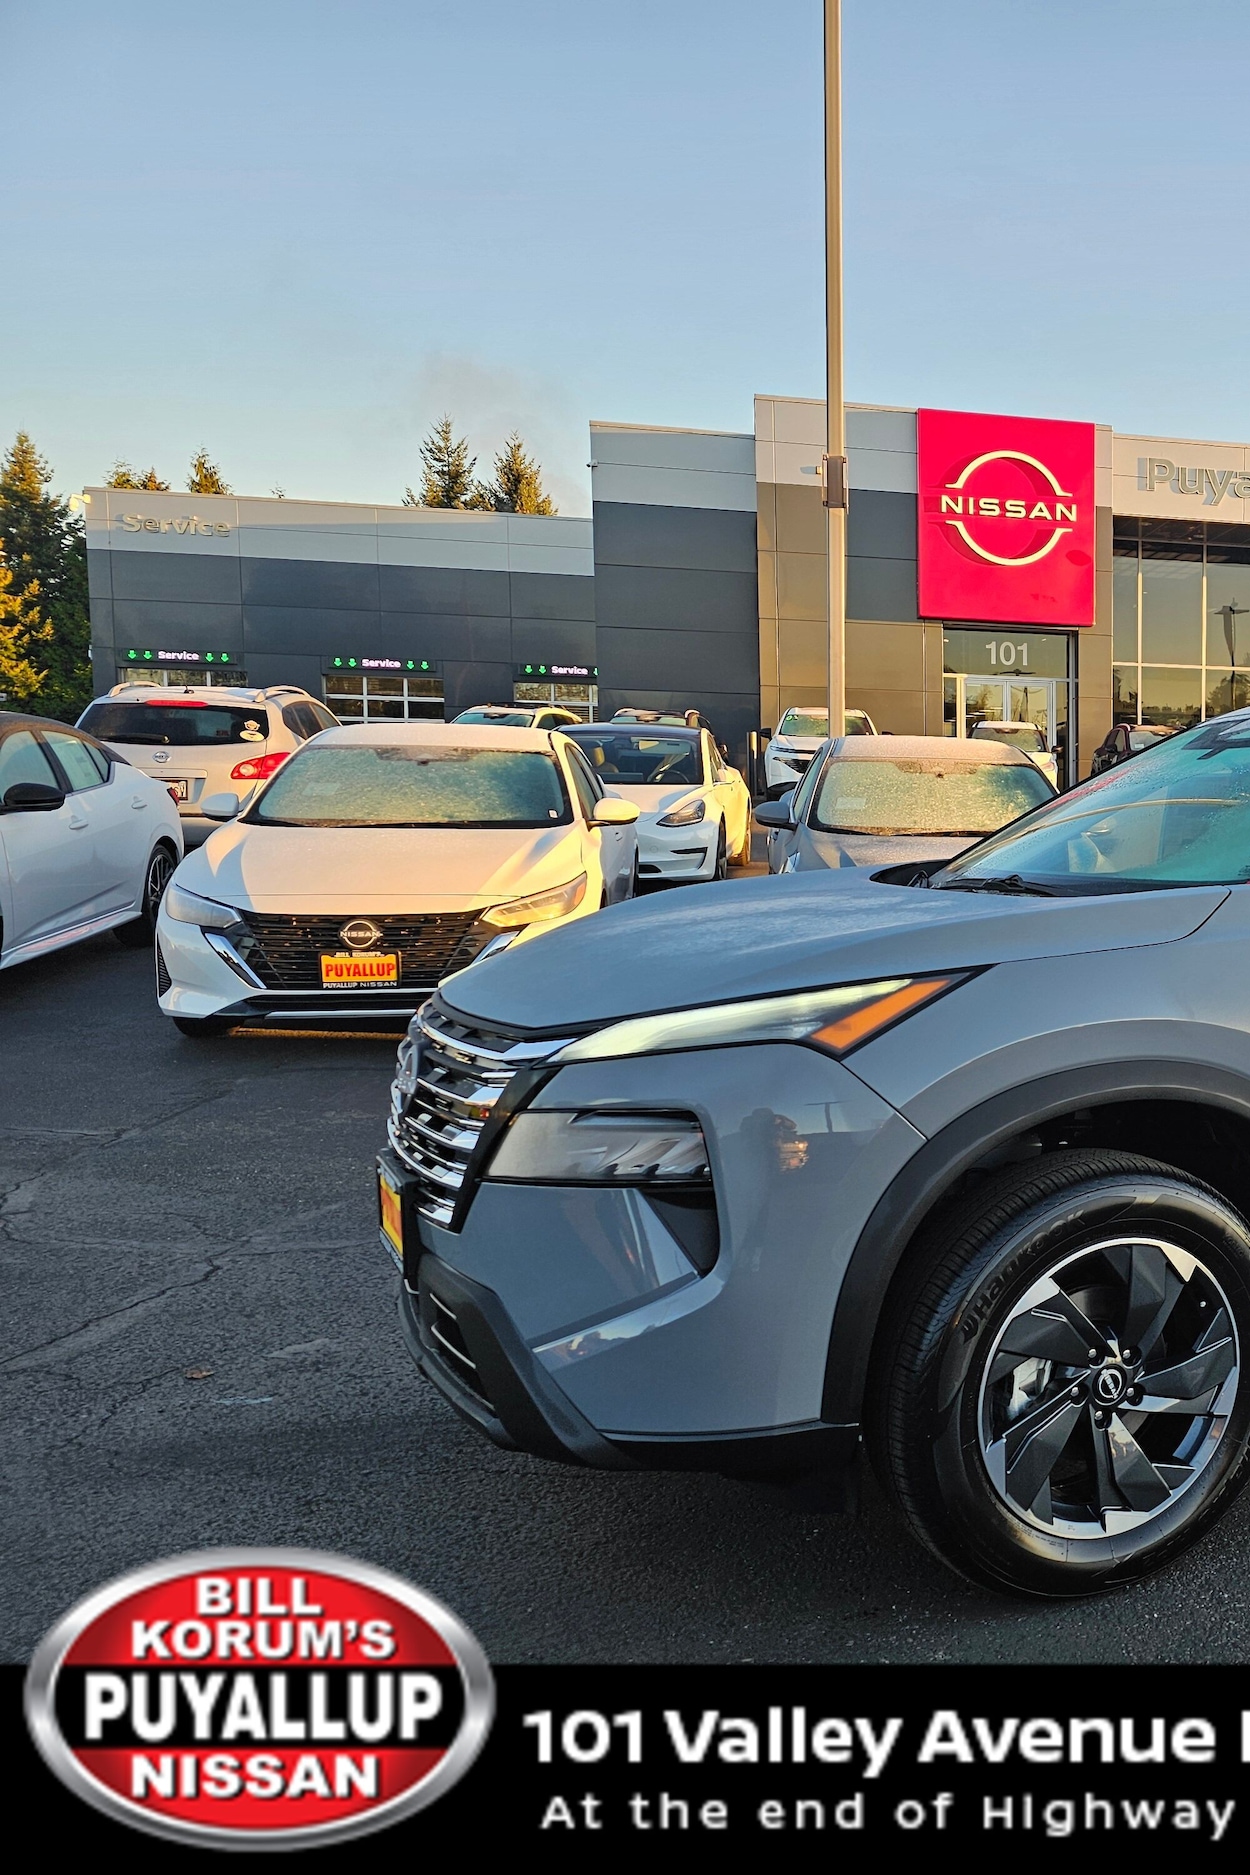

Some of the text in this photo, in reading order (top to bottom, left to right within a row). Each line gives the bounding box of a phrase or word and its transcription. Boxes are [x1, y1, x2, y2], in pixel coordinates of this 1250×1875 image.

[940, 493, 1078, 523] NISSAN
[122, 512, 231, 538] Service
[158, 650, 200, 660] Service
[985, 640, 1030, 667] 101
[361, 658, 402, 668] Service
[551, 665, 589, 675] Service
[339, 930, 381, 938] NISSAN
[324, 962, 396, 978] PUYALLUP
